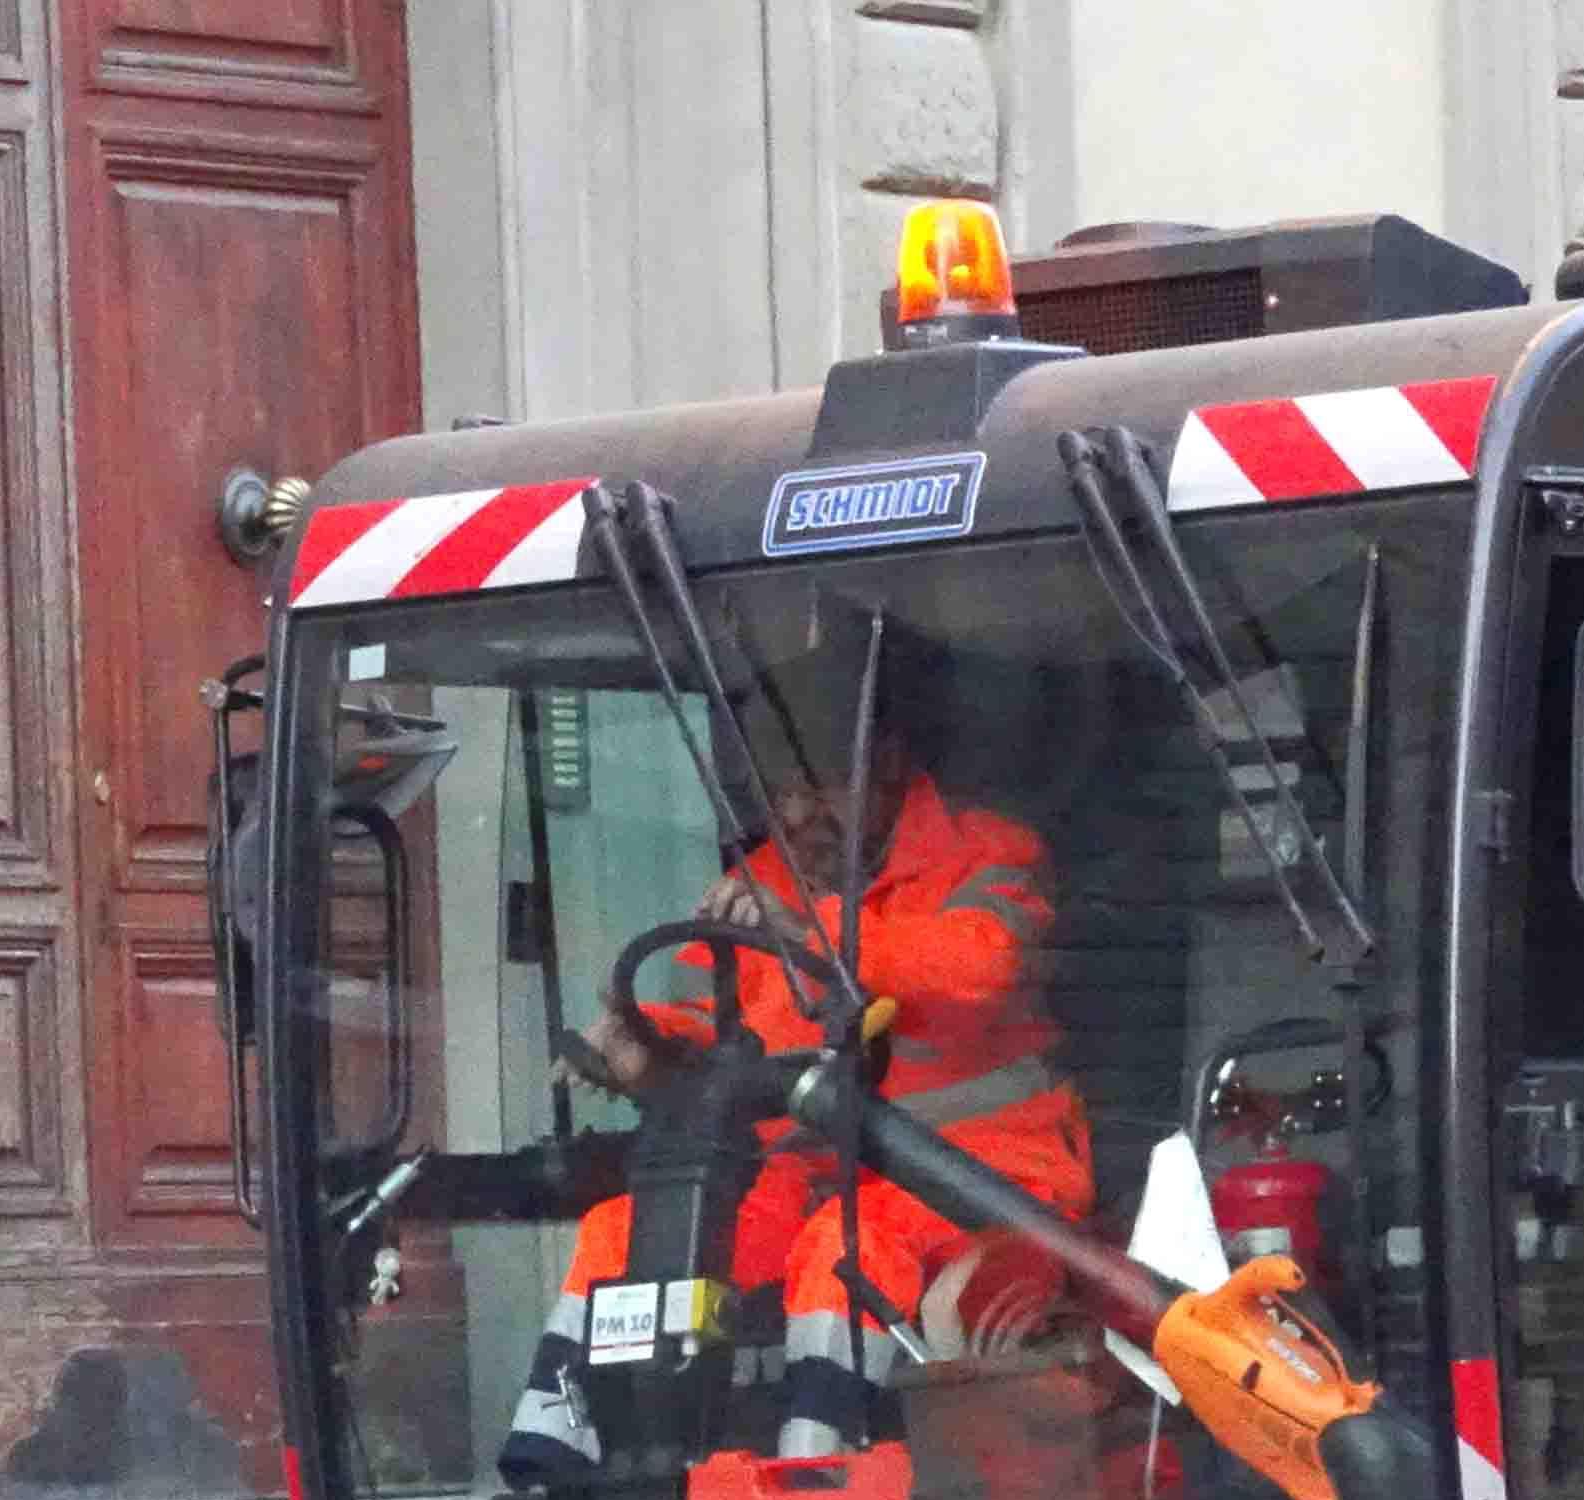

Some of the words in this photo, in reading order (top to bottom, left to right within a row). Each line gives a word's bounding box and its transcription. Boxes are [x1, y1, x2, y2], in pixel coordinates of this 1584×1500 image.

[787, 474, 959, 531] SCHMIDT
[596, 1316, 625, 1335] PM
[630, 1312, 653, 1331] 10
